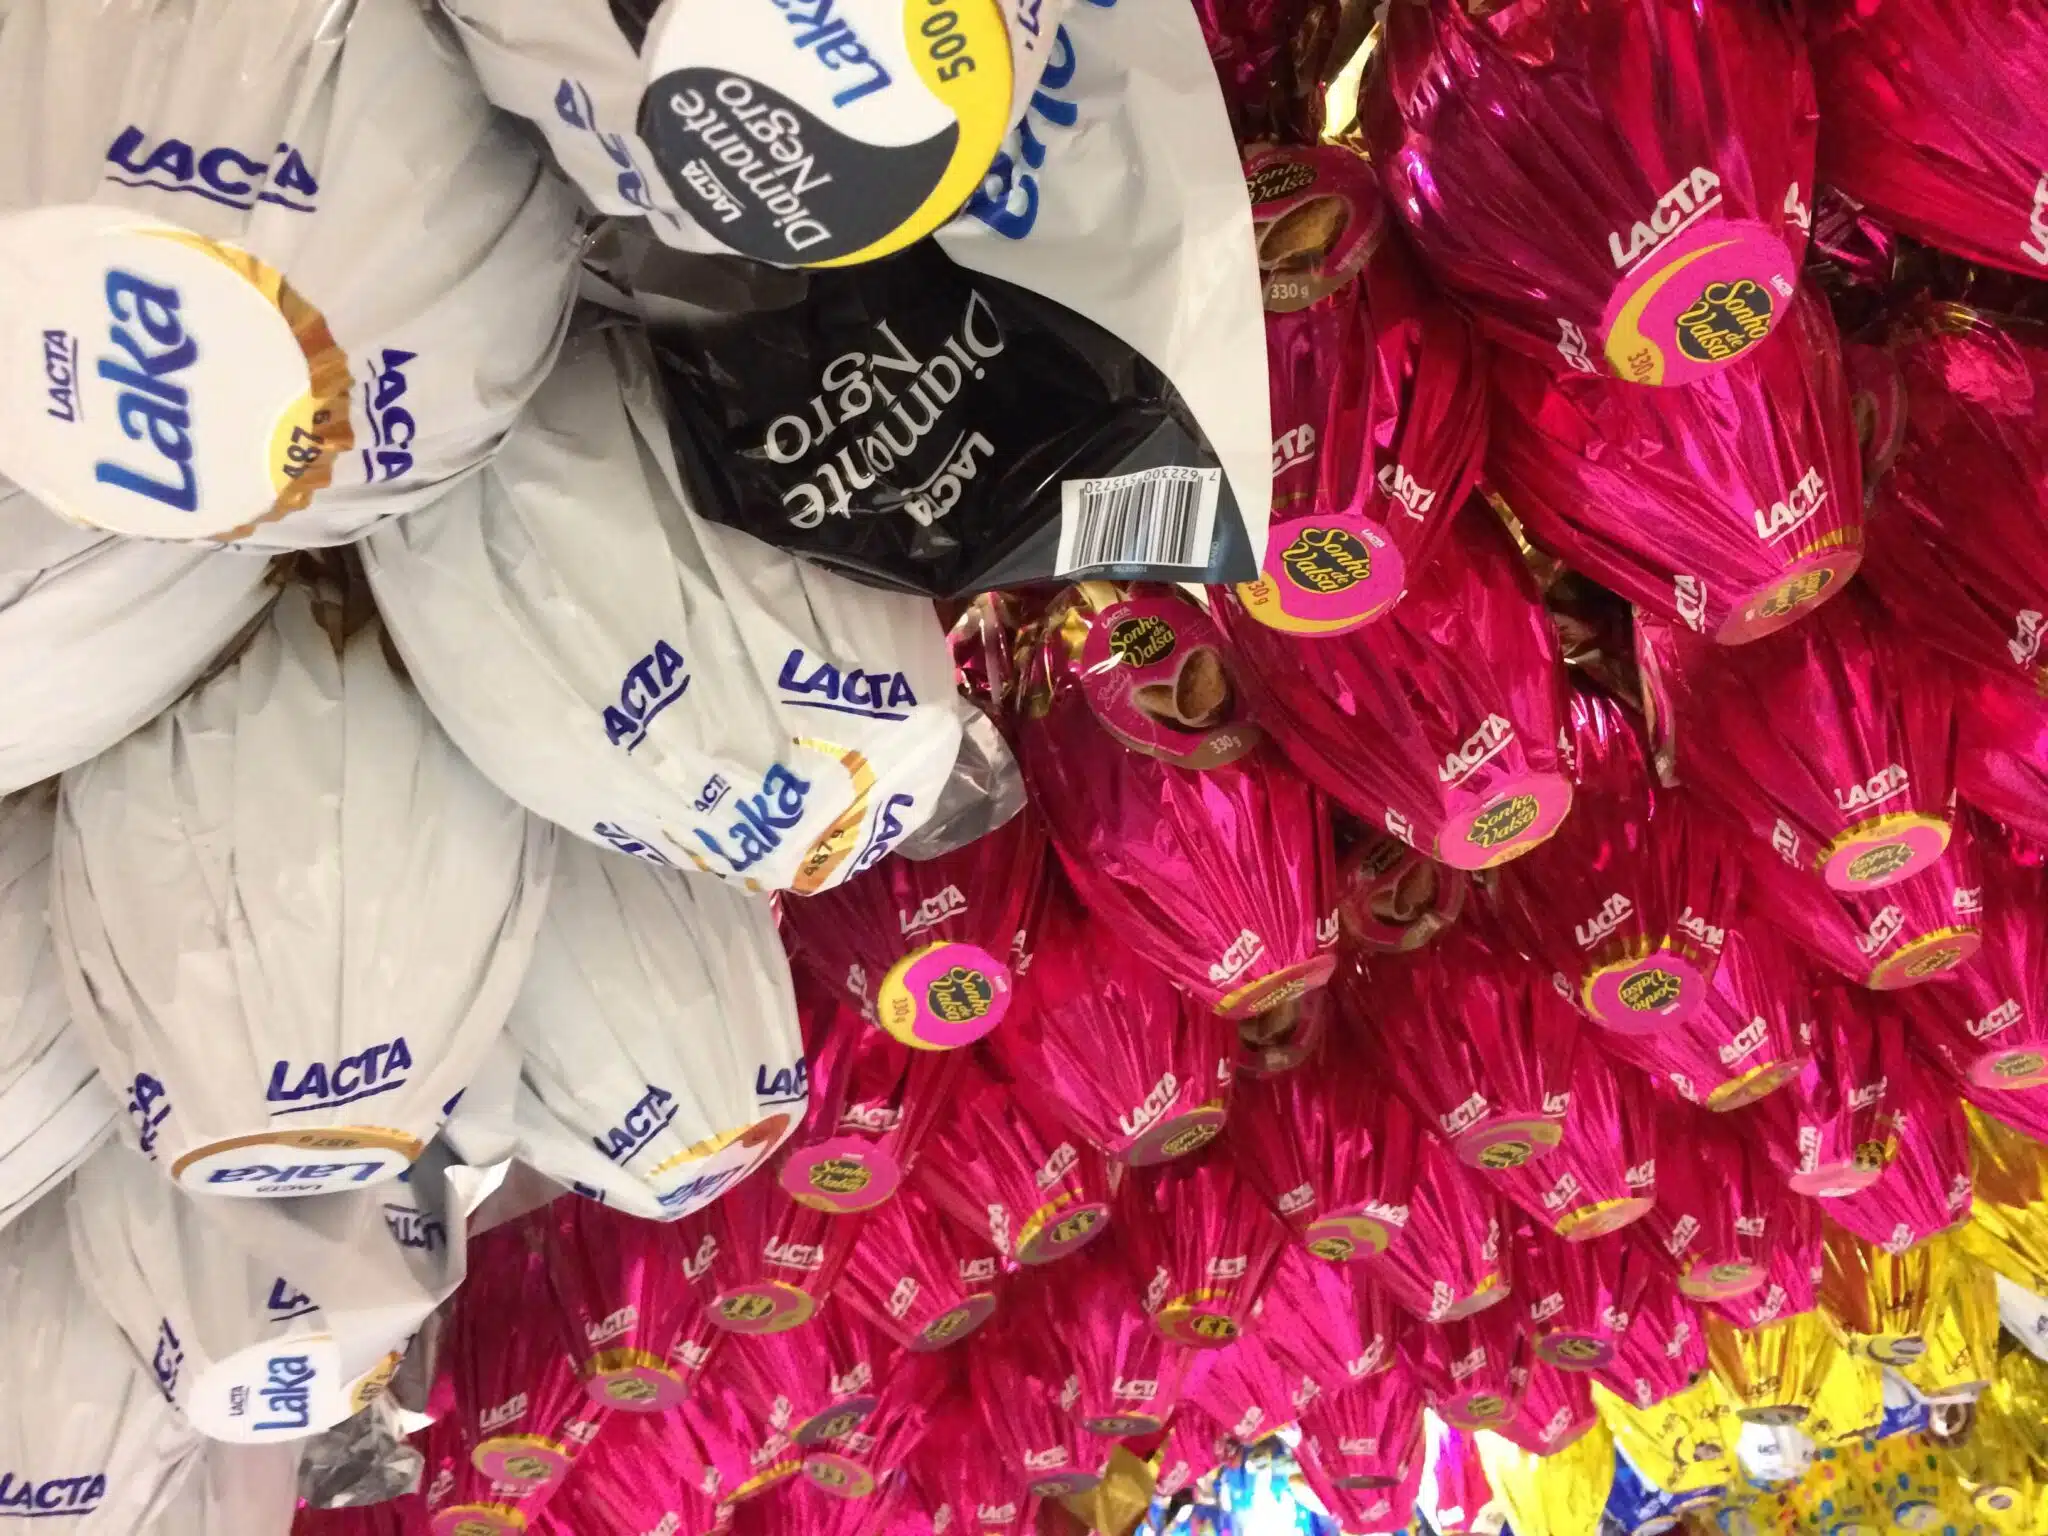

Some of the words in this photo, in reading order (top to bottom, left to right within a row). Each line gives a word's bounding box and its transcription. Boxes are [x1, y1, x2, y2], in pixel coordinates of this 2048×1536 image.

[716, 78, 833, 193] Negro
[670, 88, 831, 252] Diamante
[681, 160, 743, 225] LACTA
[1608, 166, 1721, 270] LACTA
[1677, 300, 1733, 360] Valsa
[1704, 279, 1771, 340] Sonho
[1726, 330, 1745, 348] de
[42, 330, 76, 422] LACTA
[96, 268, 199, 512] Laka
[904, 432, 994, 527] LACTA
[1754, 465, 1824, 539] LACTA
[1281, 541, 1342, 593] Valsa
[1302, 528, 1371, 580] Sonho
[1331, 570, 1349, 584] de
[1109, 614, 1160, 652] Sonho
[1122, 629, 1176, 669] Valsa
[1151, 625, 1166, 637] de
[778, 649, 918, 709] LACTA
[1834, 763, 1908, 810] LACTA
[693, 763, 811, 872] Laka
[1466, 794, 1534, 842] Sonho
[1479, 808, 1536, 848] Valsa
[1575, 893, 1631, 946] LACTA
[929, 977, 961, 1021] Valsa
[950, 966, 989, 1017] Sonho
[1966, 999, 2018, 1036] LACTA
[266, 1037, 412, 1101] LACTA
[593, 1084, 673, 1160] LACTA
[1119, 1072, 1177, 1136] LACTA
[207, 1161, 388, 1186] Laka
[228, 1385, 246, 1417] LACTA
[253, 1354, 317, 1431] Laka
